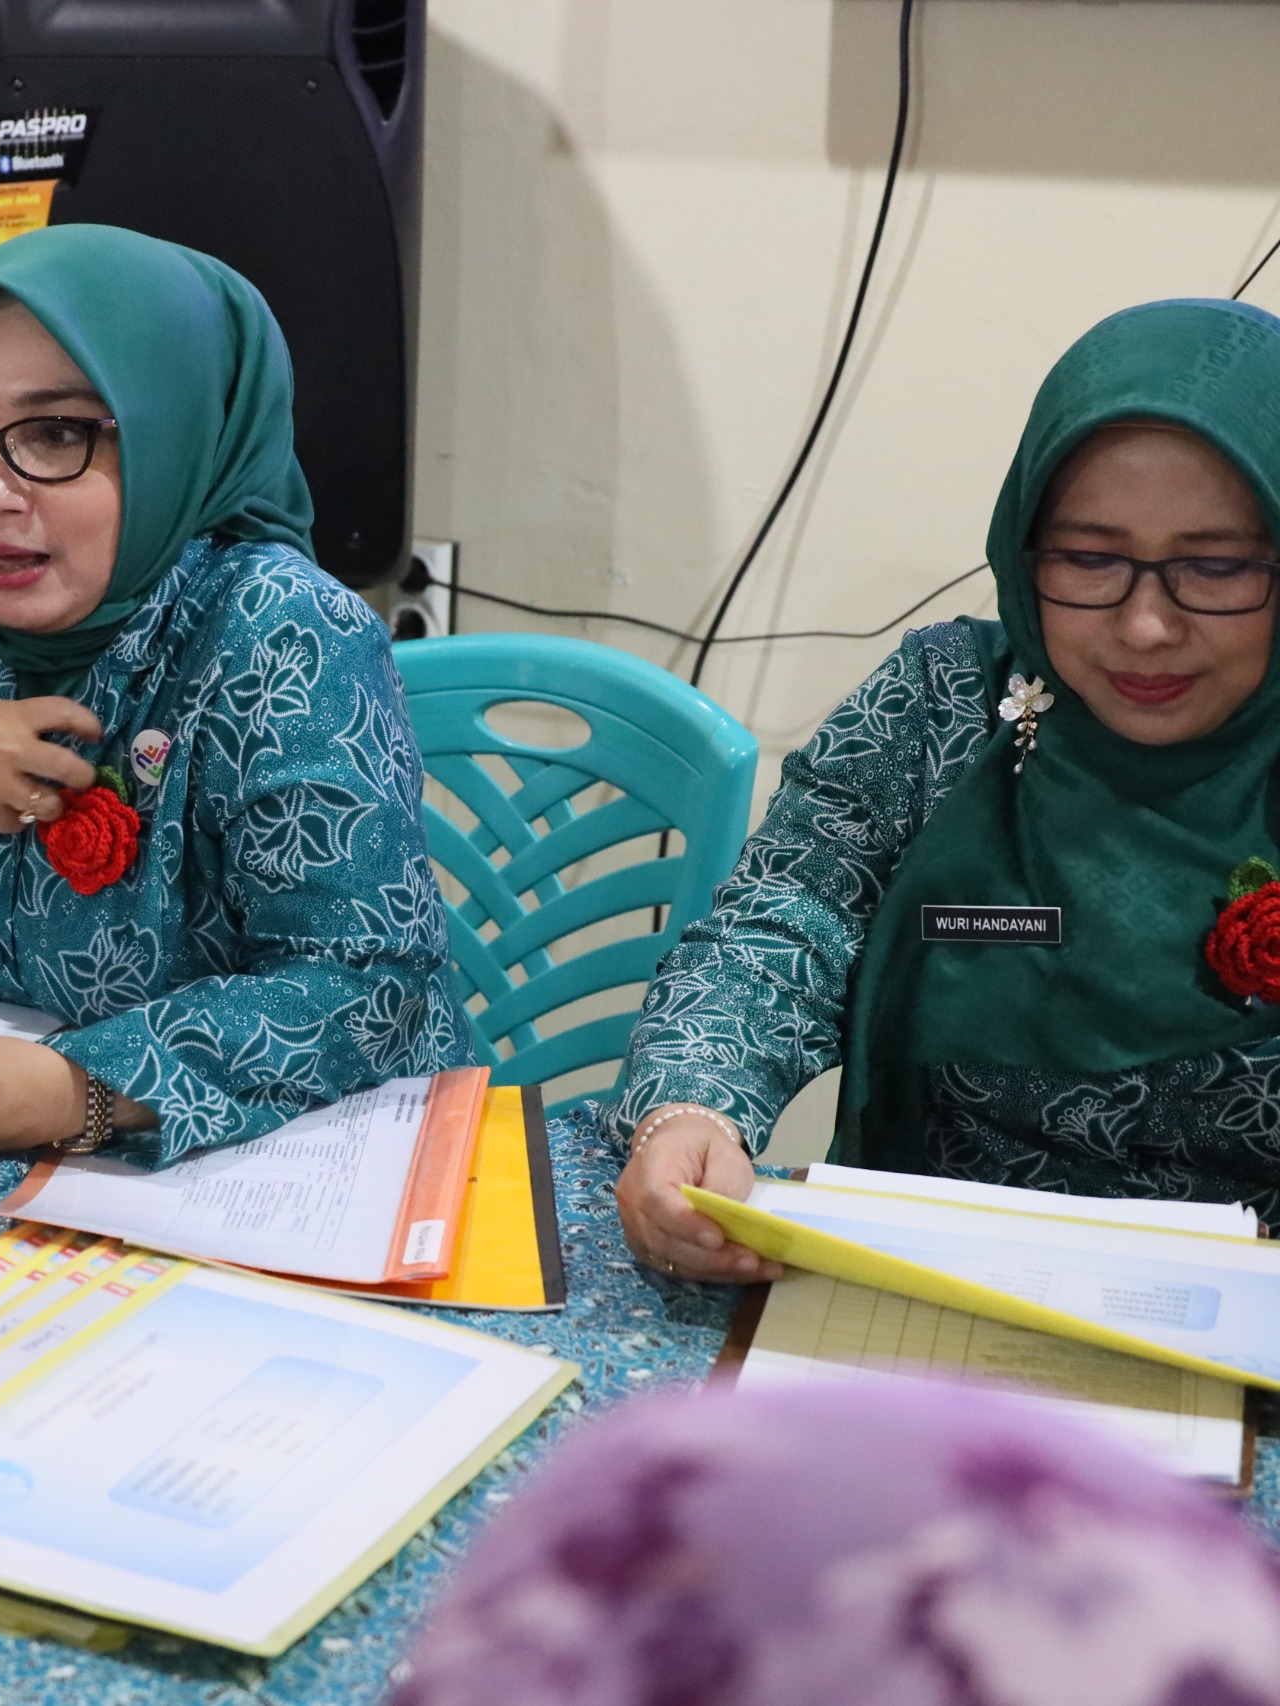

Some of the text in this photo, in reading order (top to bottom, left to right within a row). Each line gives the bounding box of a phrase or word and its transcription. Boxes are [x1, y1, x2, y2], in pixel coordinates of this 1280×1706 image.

[11, 153, 64, 172] Bluetooth
[935, 917, 1047, 932] WURI HANDAYANI
